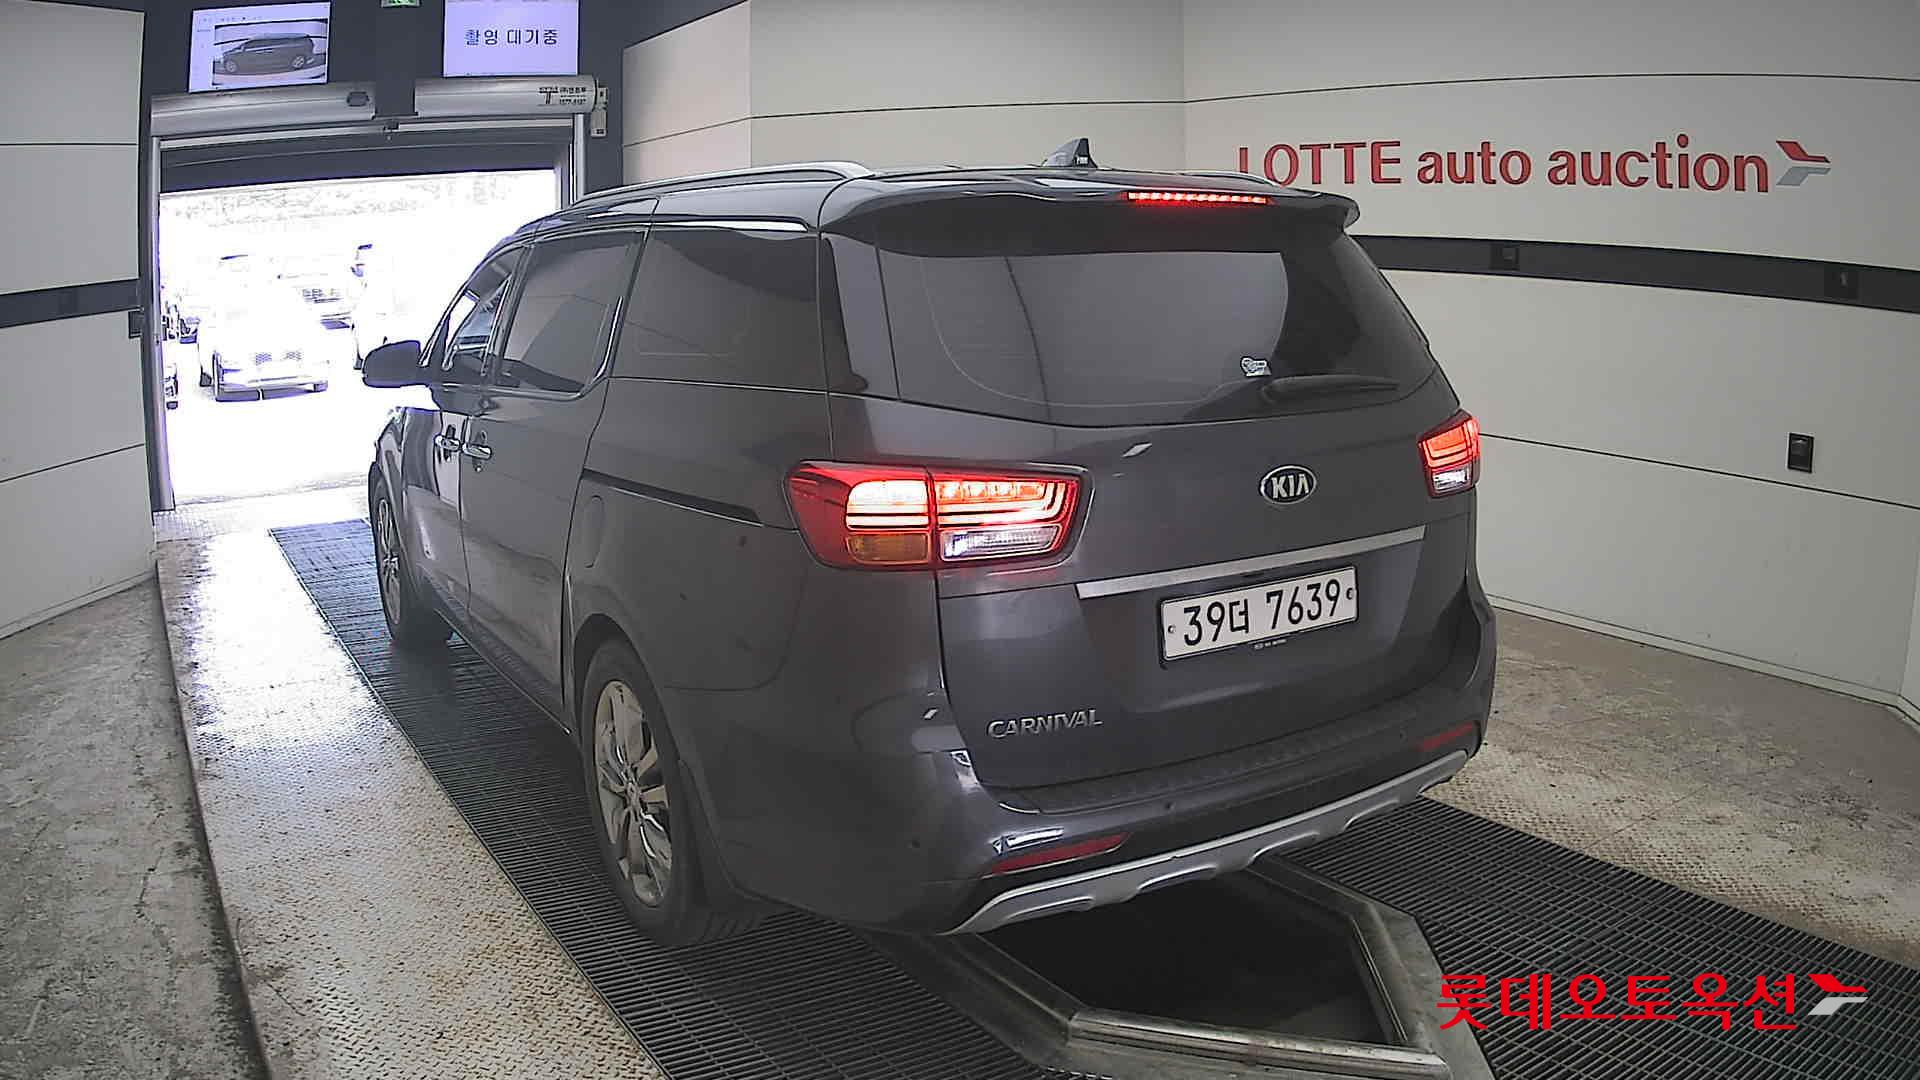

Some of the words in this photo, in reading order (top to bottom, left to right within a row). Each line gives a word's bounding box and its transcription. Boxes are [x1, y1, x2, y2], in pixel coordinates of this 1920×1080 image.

[507, 29, 558, 45] 대기중
[1417, 141, 1531, 186] auto
[1547, 133, 1769, 193] auction
[1271, 473, 1310, 499] KIA
[1183, 599, 1249, 646] 39더
[1266, 579, 1341, 630] 7639
[987, 708, 1103, 739] CARNIVAL
